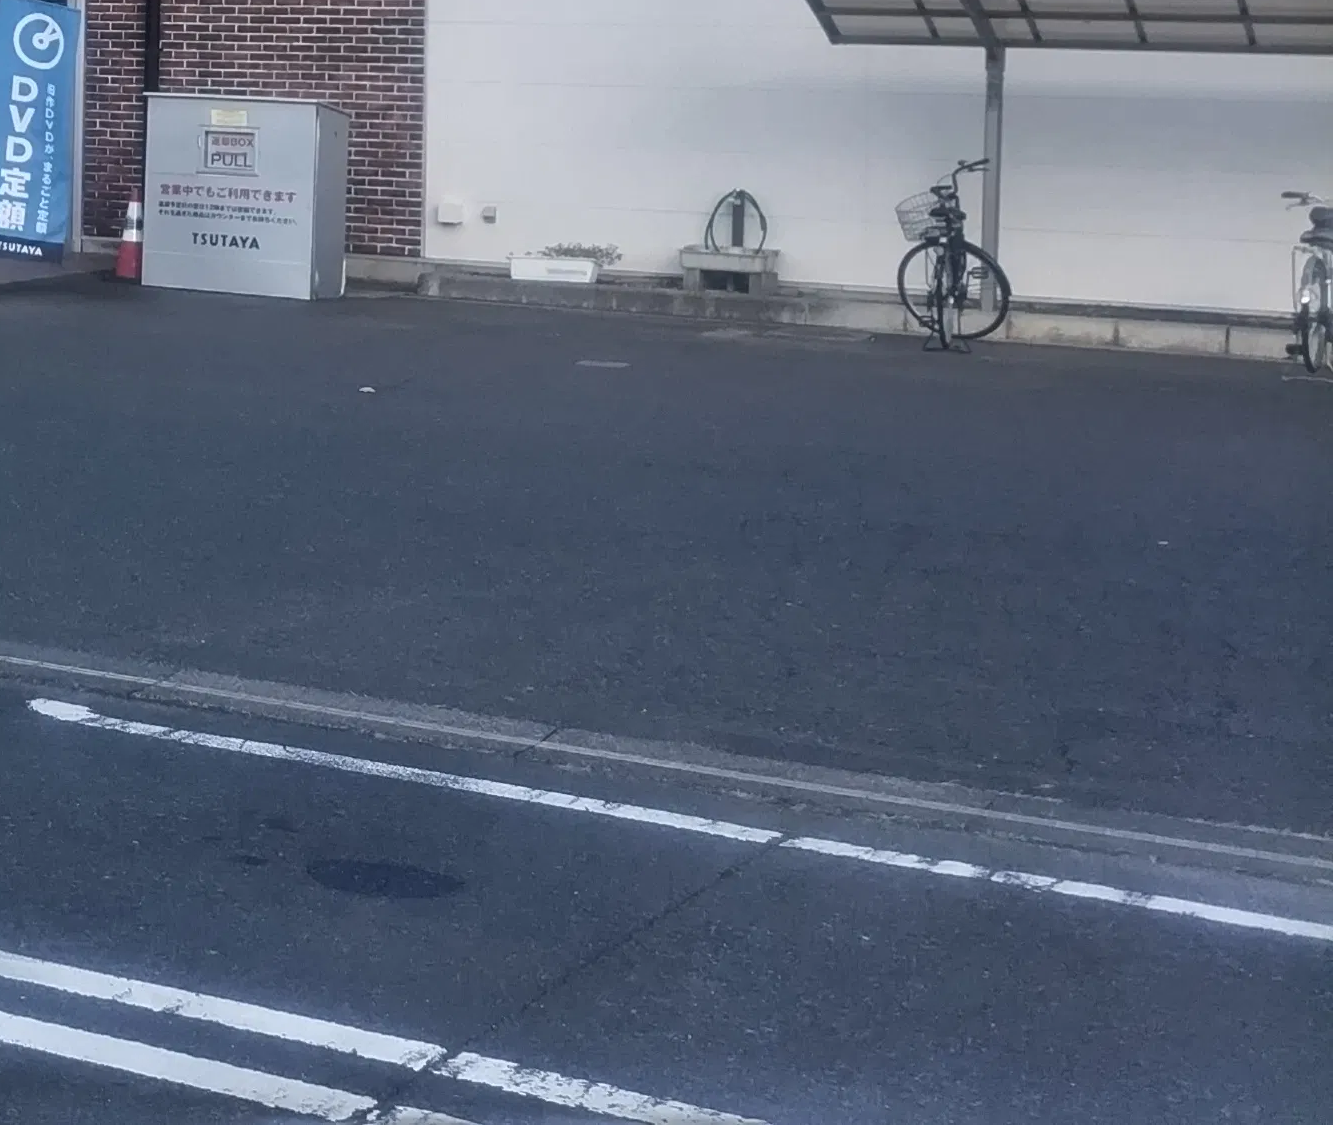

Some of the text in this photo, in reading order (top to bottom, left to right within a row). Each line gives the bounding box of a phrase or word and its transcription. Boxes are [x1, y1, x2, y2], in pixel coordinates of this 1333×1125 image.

[211, 152, 253, 168] PULL
[160, 184, 297, 203] 営業中でもご利用できます
[192, 232, 261, 250] TSUTAYA
